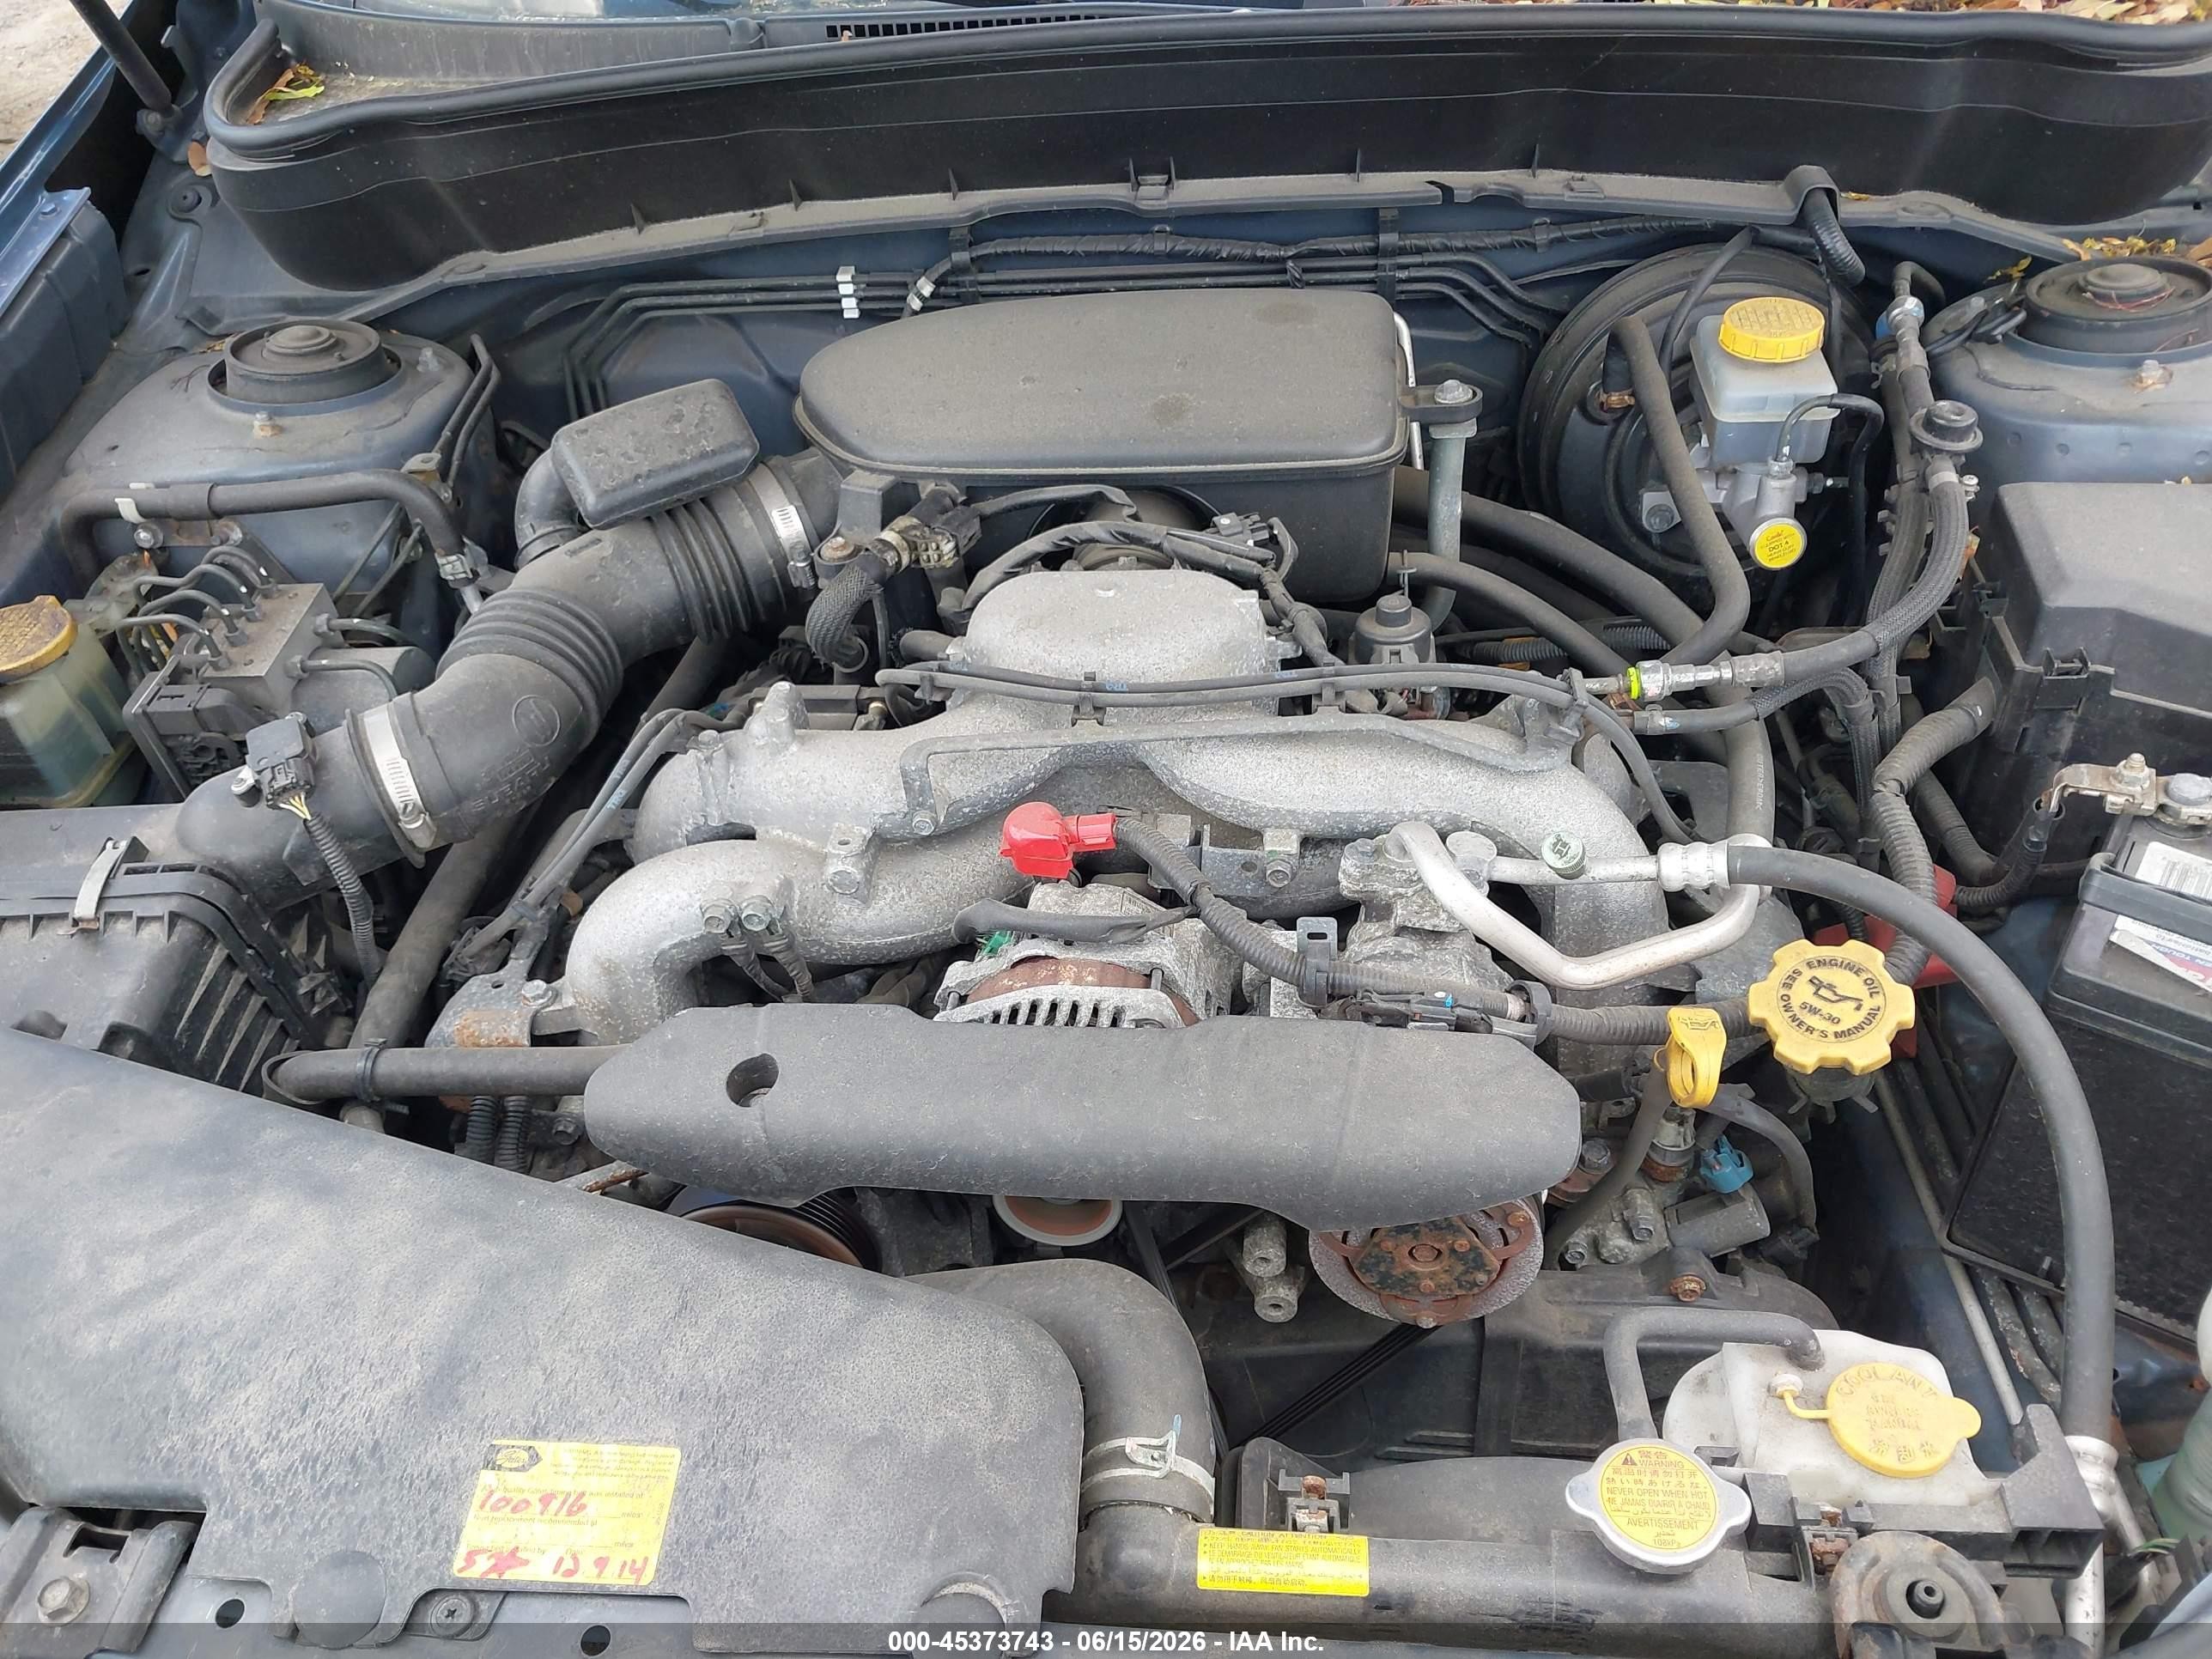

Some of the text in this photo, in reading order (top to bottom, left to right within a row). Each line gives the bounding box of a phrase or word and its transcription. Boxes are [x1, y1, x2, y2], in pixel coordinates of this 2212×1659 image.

[1806, 957, 1881, 1000] ENGINE OIL
[1780, 967, 1881, 1040] SEE OWNER'S MANUAL
[1799, 1001, 1841, 1025] 5W-30
[1837, 1365, 1938, 1400] COOLANT
[1639, 1460, 1685, 1469] WARNING
[1607, 1486, 1709, 1499] NEVER OPEN WHEN HOT
[1627, 1517, 1699, 1530] AVERTISSEMENT
[1310, 1546, 1361, 1555] AUTOMATICALLY
